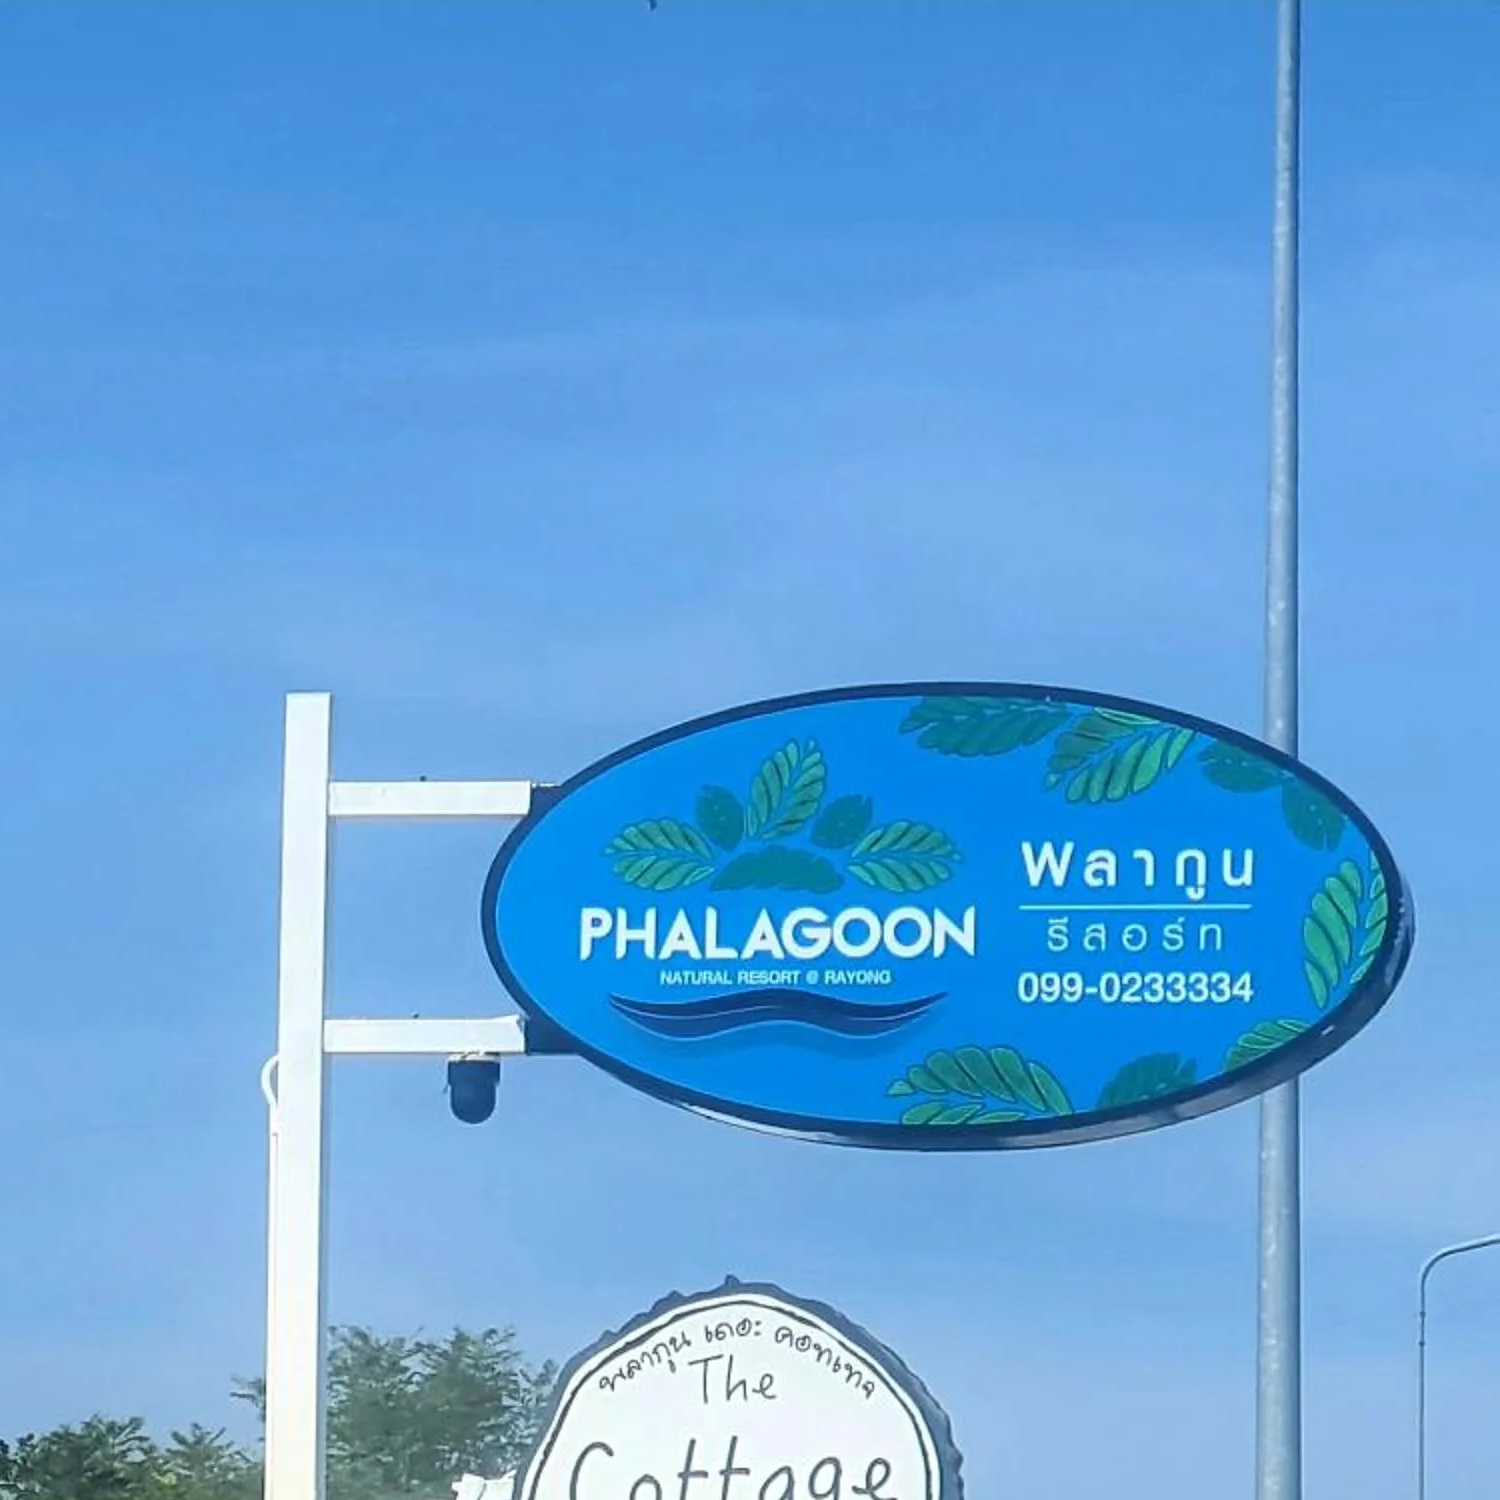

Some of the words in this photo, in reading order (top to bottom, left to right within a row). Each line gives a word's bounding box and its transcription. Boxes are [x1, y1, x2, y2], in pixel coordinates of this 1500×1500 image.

[1021, 841, 1254, 901] พลากูน
[580, 905, 976, 961] PHALAGOON
[660, 970, 733, 985] NATURAL
[738, 970, 801, 985] RESORT
[824, 970, 892, 985] RAYONG
[1017, 971, 1254, 1003] 099-0233334
[704, 1317, 763, 1343] เดอะ
[687, 1353, 778, 1405] The
